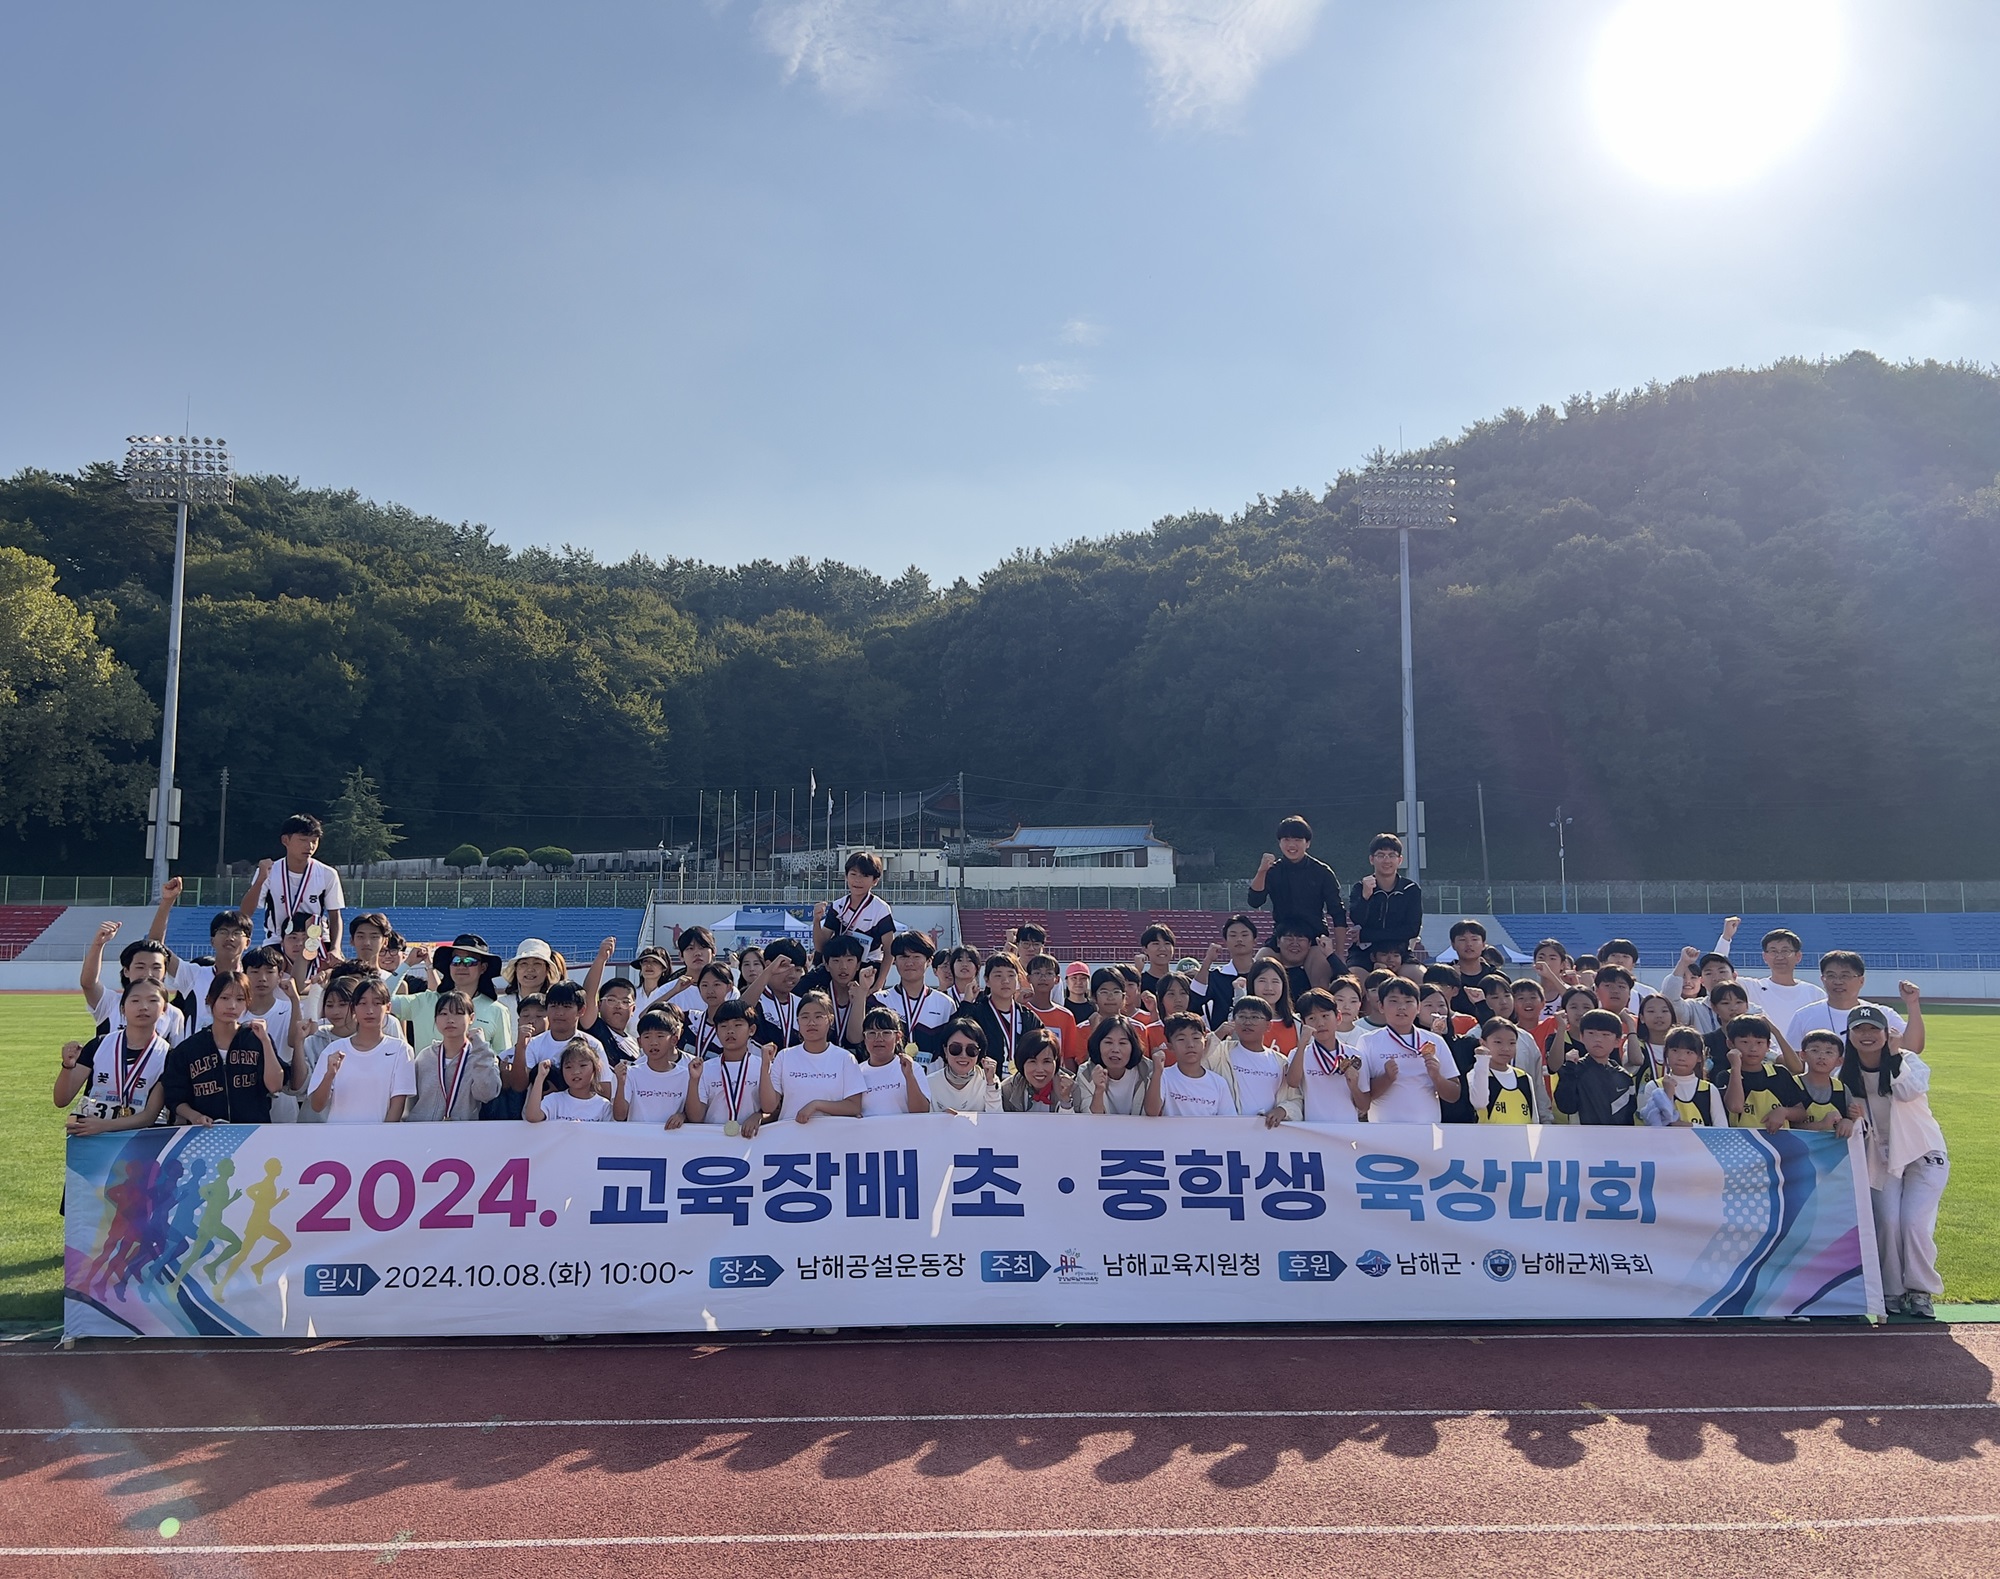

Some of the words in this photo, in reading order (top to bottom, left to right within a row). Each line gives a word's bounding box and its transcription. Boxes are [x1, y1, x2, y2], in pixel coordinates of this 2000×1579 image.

[295, 1157, 558, 1233] 2024.
[589, 1149, 920, 1227] 교육장배
[951, 1147, 1025, 1218] 초
[1097, 1149, 1327, 1222] 중학생
[1355, 1153, 1657, 1225] 육상대회
[316, 1267, 362, 1292] 일시
[384, 1260, 591, 1289] 2024.10.08.(화)
[600, 1261, 694, 1285] 10:00~
[719, 1259, 766, 1284] 장소
[797, 1252, 967, 1280] 남해공설운동장
[990, 1254, 1034, 1278] 주최
[1103, 1252, 1261, 1277] 남해교육지원청
[1288, 1254, 1331, 1277] 후원
[1396, 1252, 1462, 1276] 남해군
[1521, 1252, 1654, 1275] 남해군체육회
